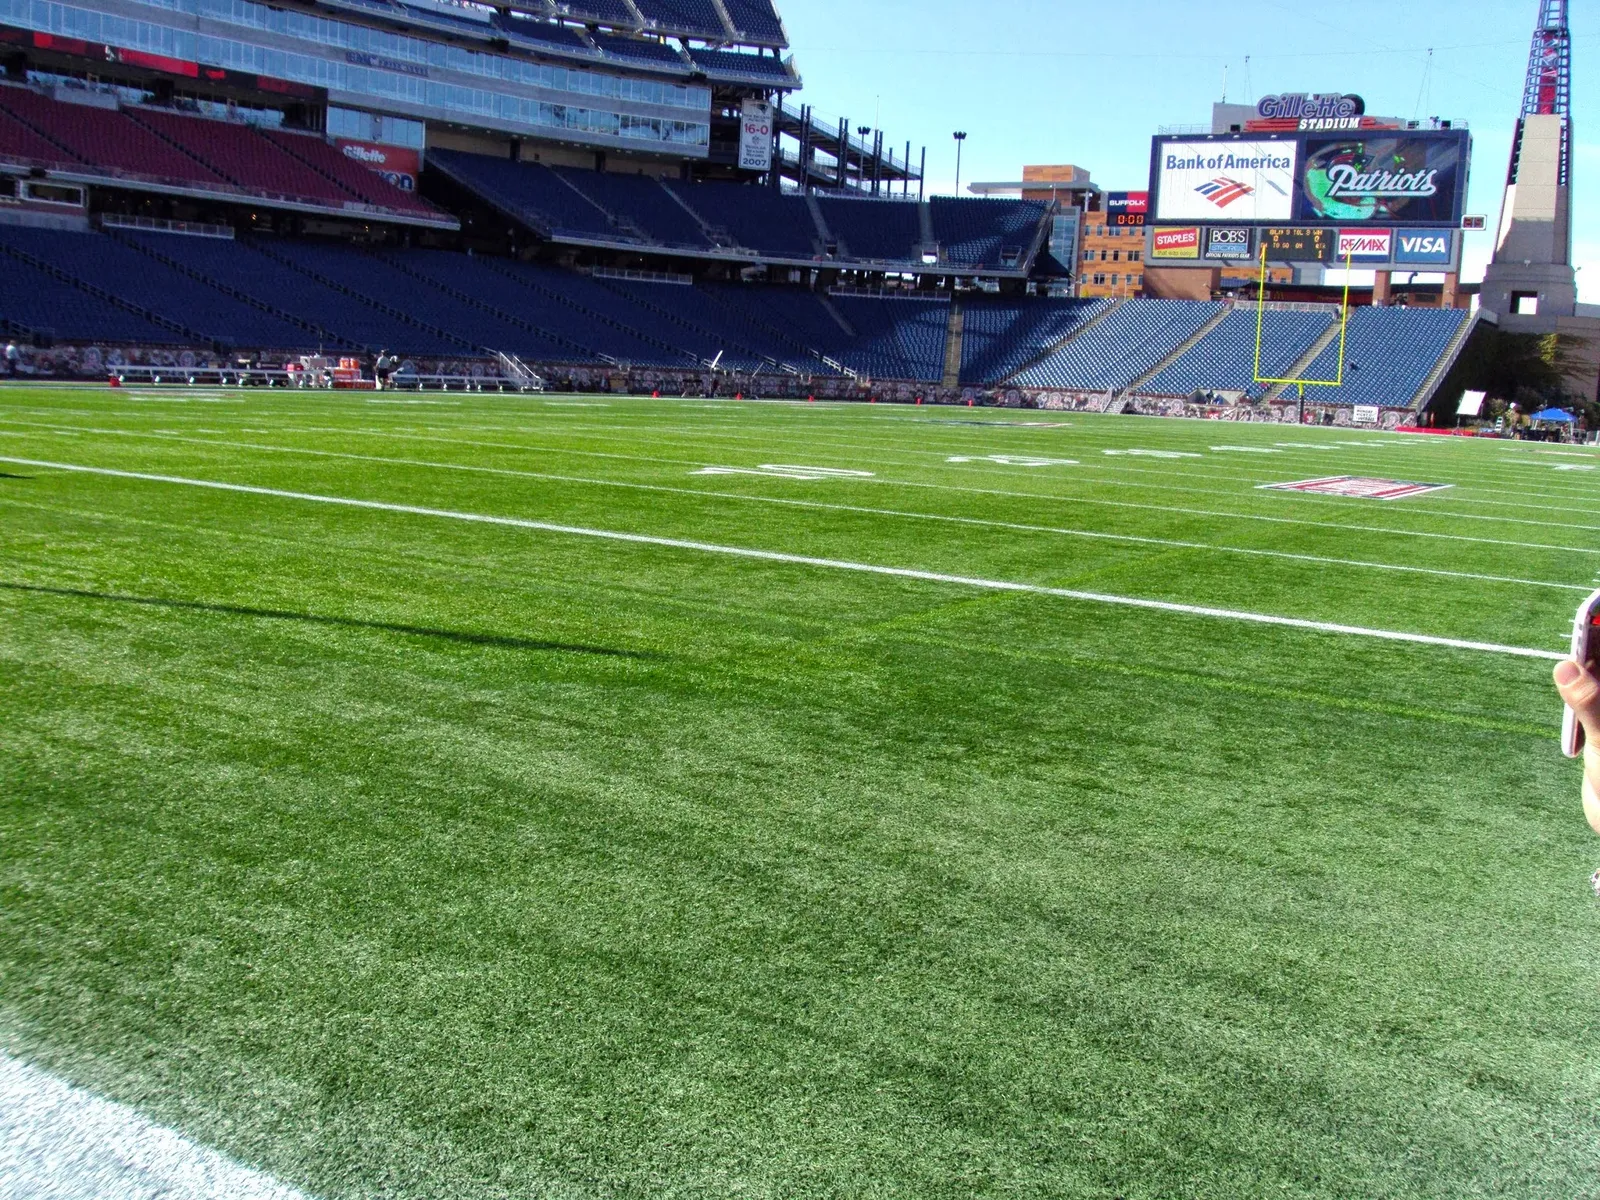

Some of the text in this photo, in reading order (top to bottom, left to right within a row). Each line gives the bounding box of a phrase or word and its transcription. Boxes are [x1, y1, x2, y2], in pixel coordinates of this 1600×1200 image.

[1257, 92, 1356, 119] Gillette
[1299, 117, 1361, 130] STADIUM
[342, 145, 386, 163] Gillette
[743, 157, 767, 166] 2007
[1166, 153, 1291, 170] Bank of America
[1327, 163, 1438, 197] Patriots
[1117, 214, 1144, 225] 0:00
[1157, 232, 1195, 245] STAPLES
[1212, 230, 1246, 243] BOB'S
[1340, 237, 1387, 251] RE/MAX
[1399, 237, 1446, 253] VISA
